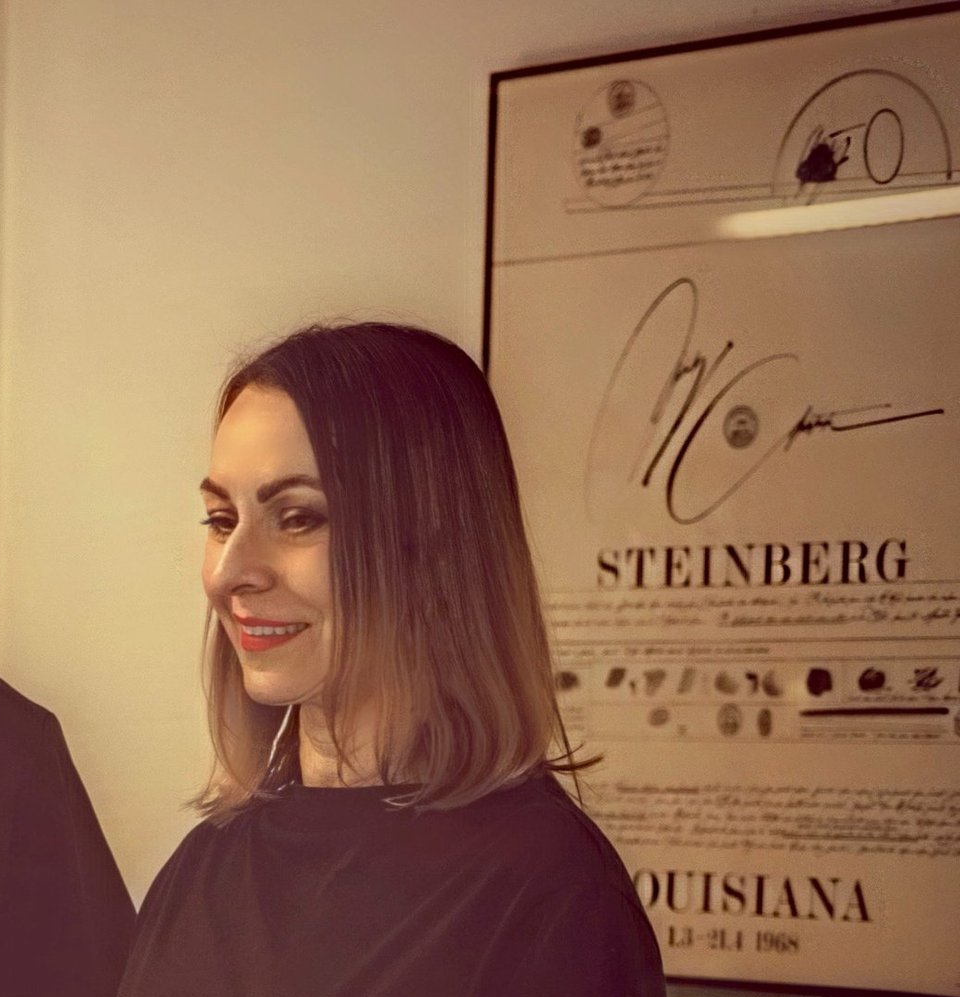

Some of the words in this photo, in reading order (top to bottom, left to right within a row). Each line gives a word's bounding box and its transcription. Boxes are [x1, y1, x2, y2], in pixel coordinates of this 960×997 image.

[597, 537, 910, 589] STEINBERG
[632, 867, 872, 923] OUISIANA
[755, 929, 800, 954] 1968
